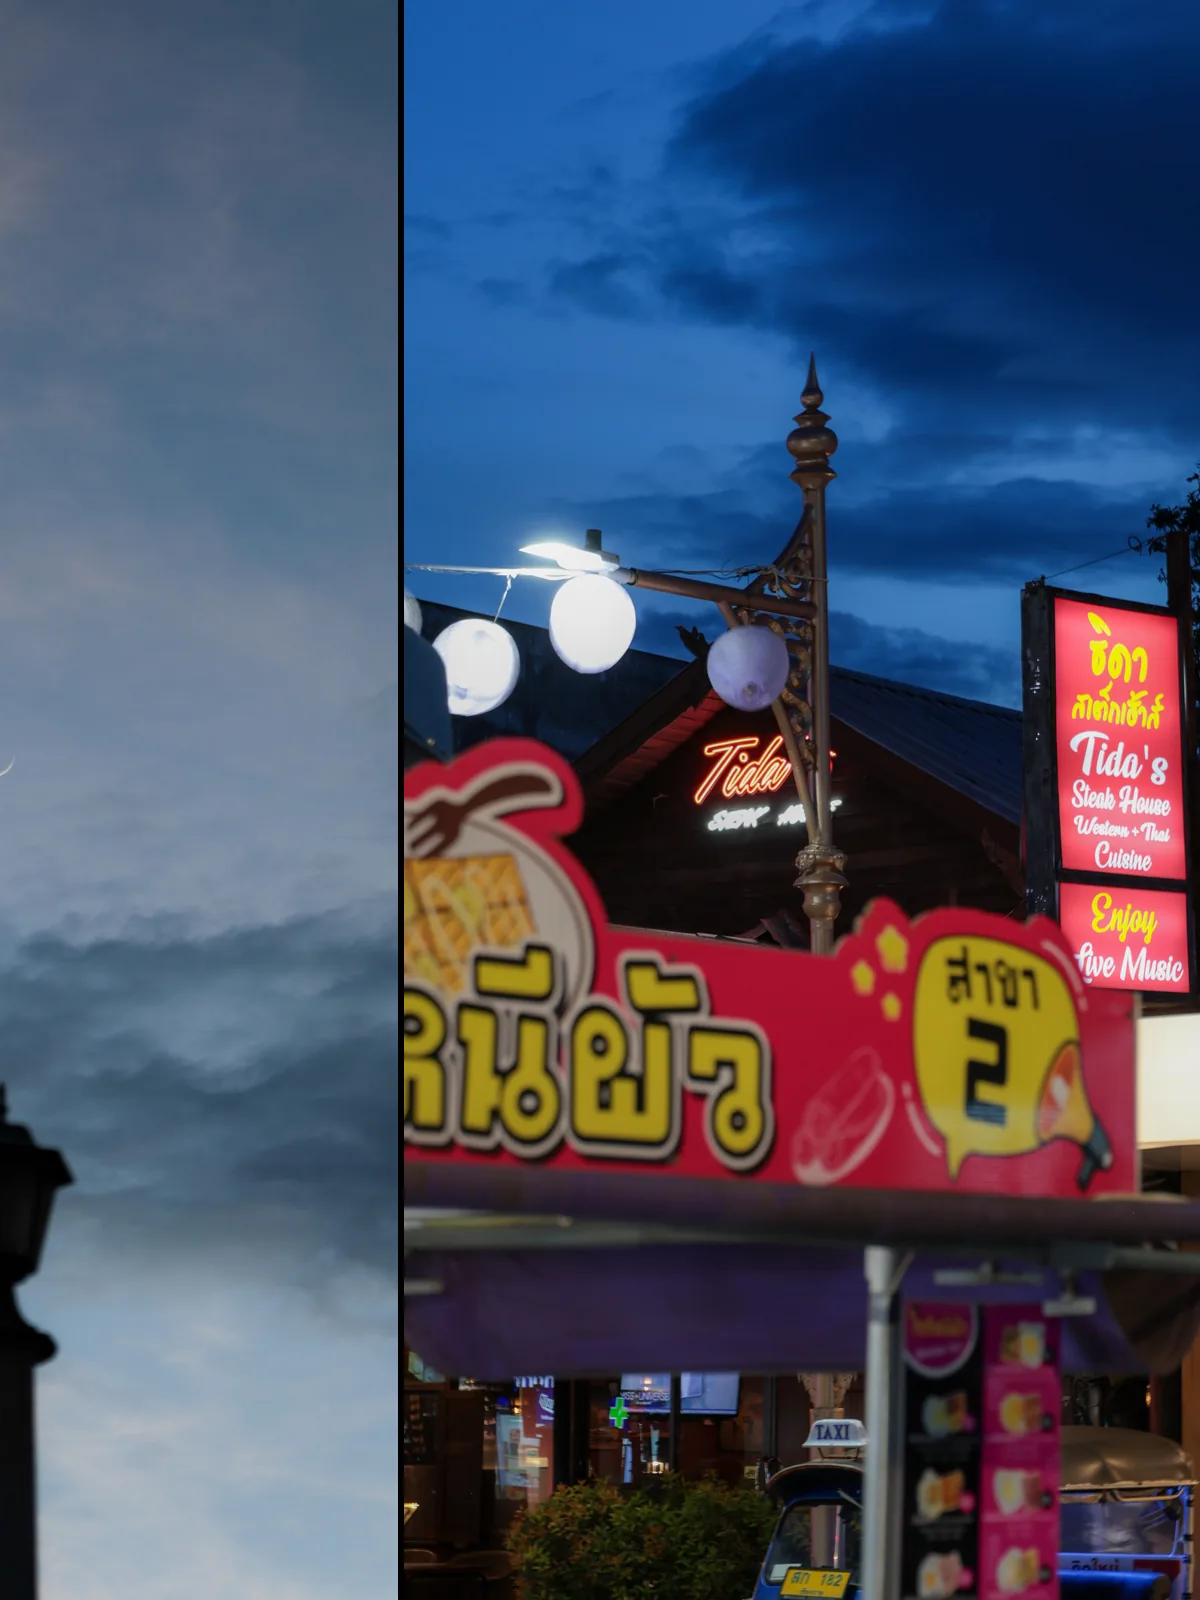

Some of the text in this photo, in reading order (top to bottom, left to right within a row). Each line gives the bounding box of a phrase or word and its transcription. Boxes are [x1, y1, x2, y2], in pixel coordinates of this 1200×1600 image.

[1069, 730, 1169, 785] Tida's
[1071, 779, 1171, 817] Steak House
[1073, 814, 1129, 838] Western
[1140, 822, 1170, 843] Thai
[1094, 840, 1153, 872] Cuisine
[1091, 892, 1158, 945] Enjoy
[946, 944, 1040, 1011] สาขา
[1119, 945, 1184, 982] Music
[965, 1017, 1008, 1129] 2
[815, 1424, 850, 1440] TAXI
